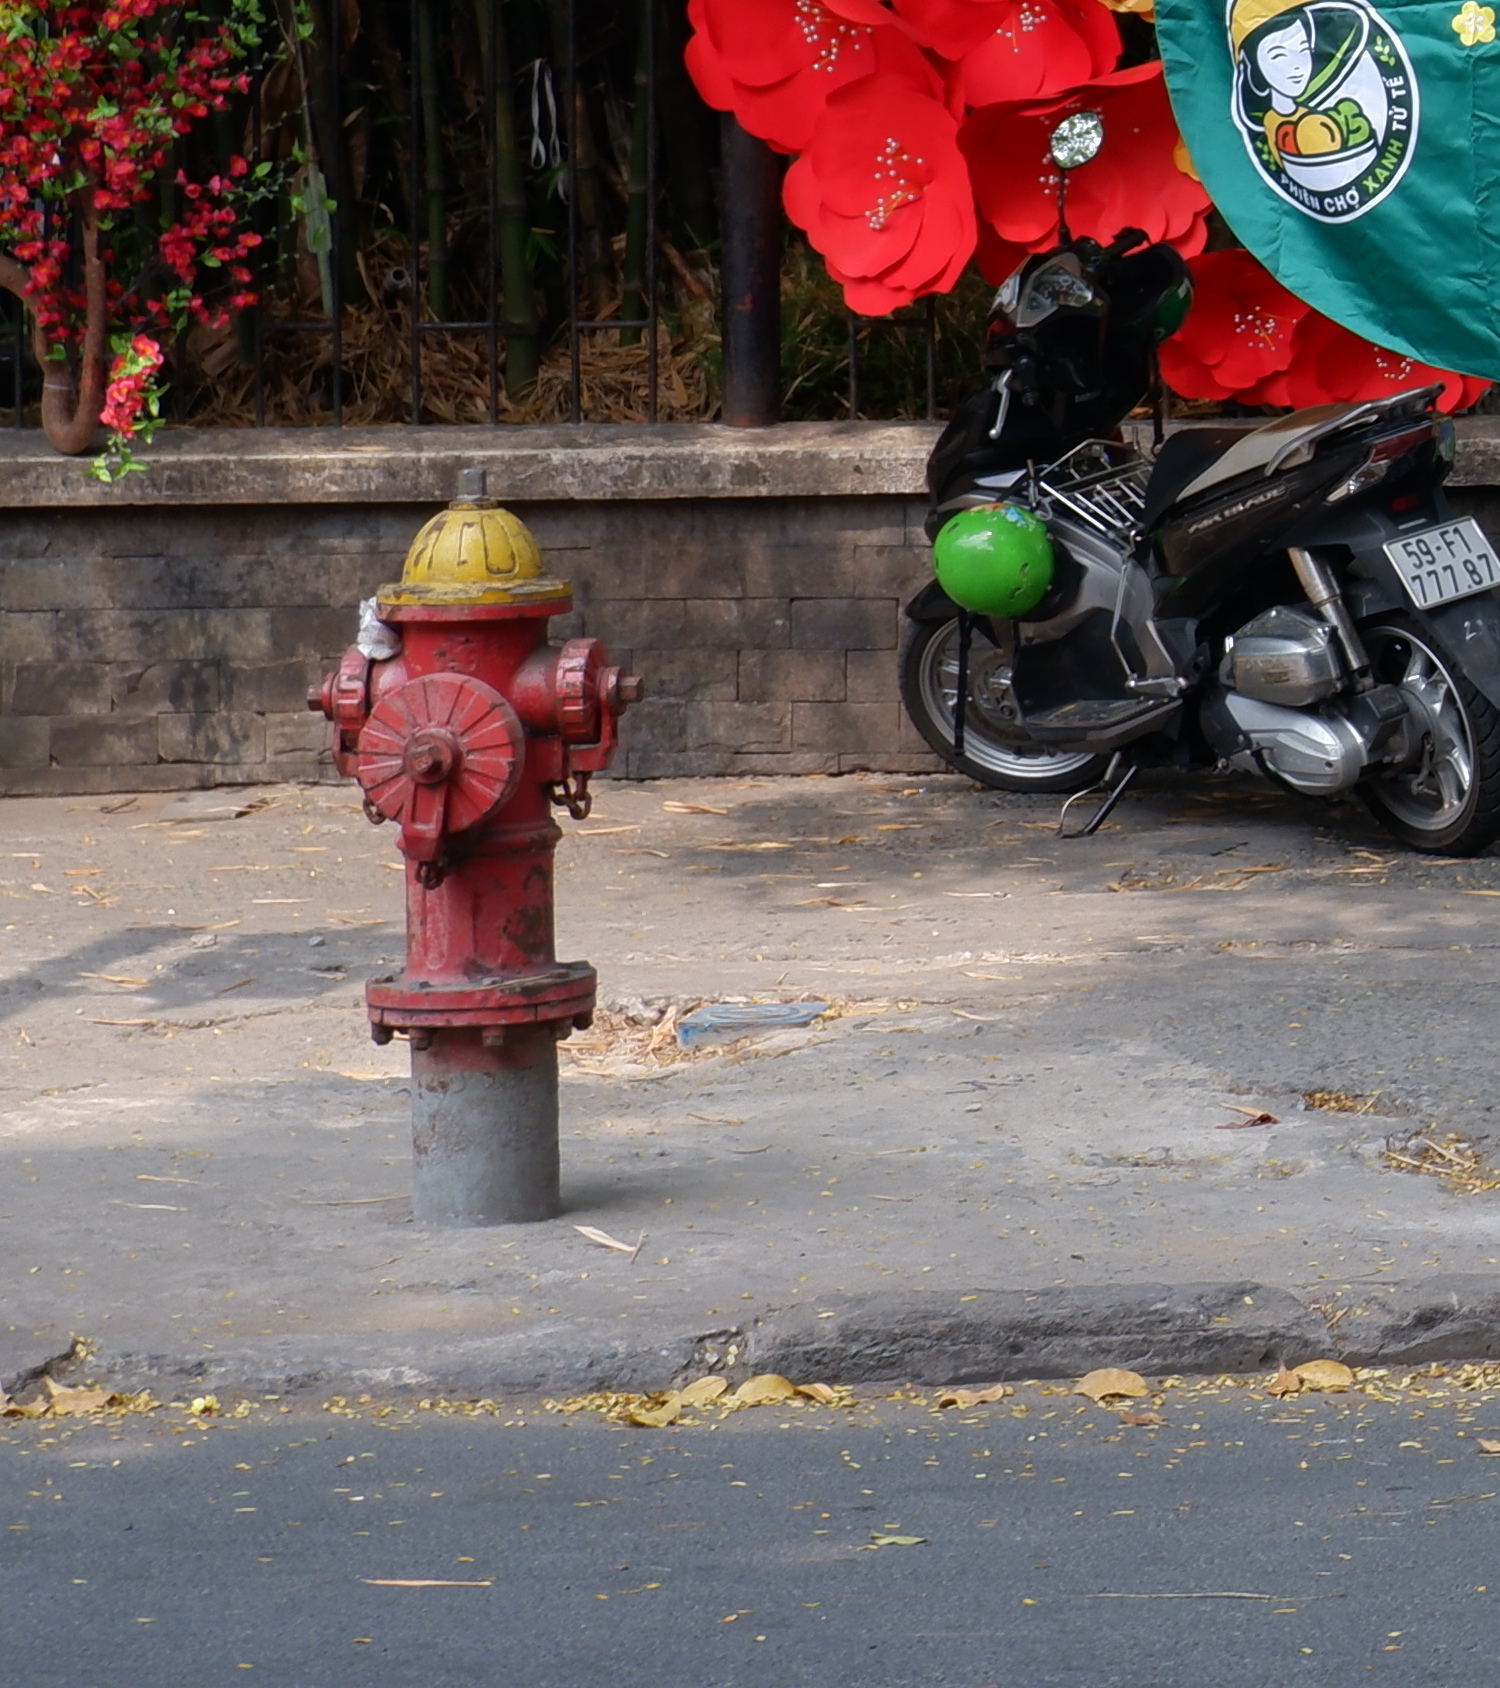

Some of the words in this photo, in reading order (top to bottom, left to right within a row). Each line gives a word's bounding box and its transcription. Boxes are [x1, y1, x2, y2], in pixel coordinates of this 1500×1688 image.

[1280, 173, 1320, 211] PHIÊN
[1323, 186, 1360, 213] CHỢ
[1362, 138, 1403, 194] XANH
[1402, 526, 1472, 570] 59-F1
[1411, 553, 1494, 604] 777.87
